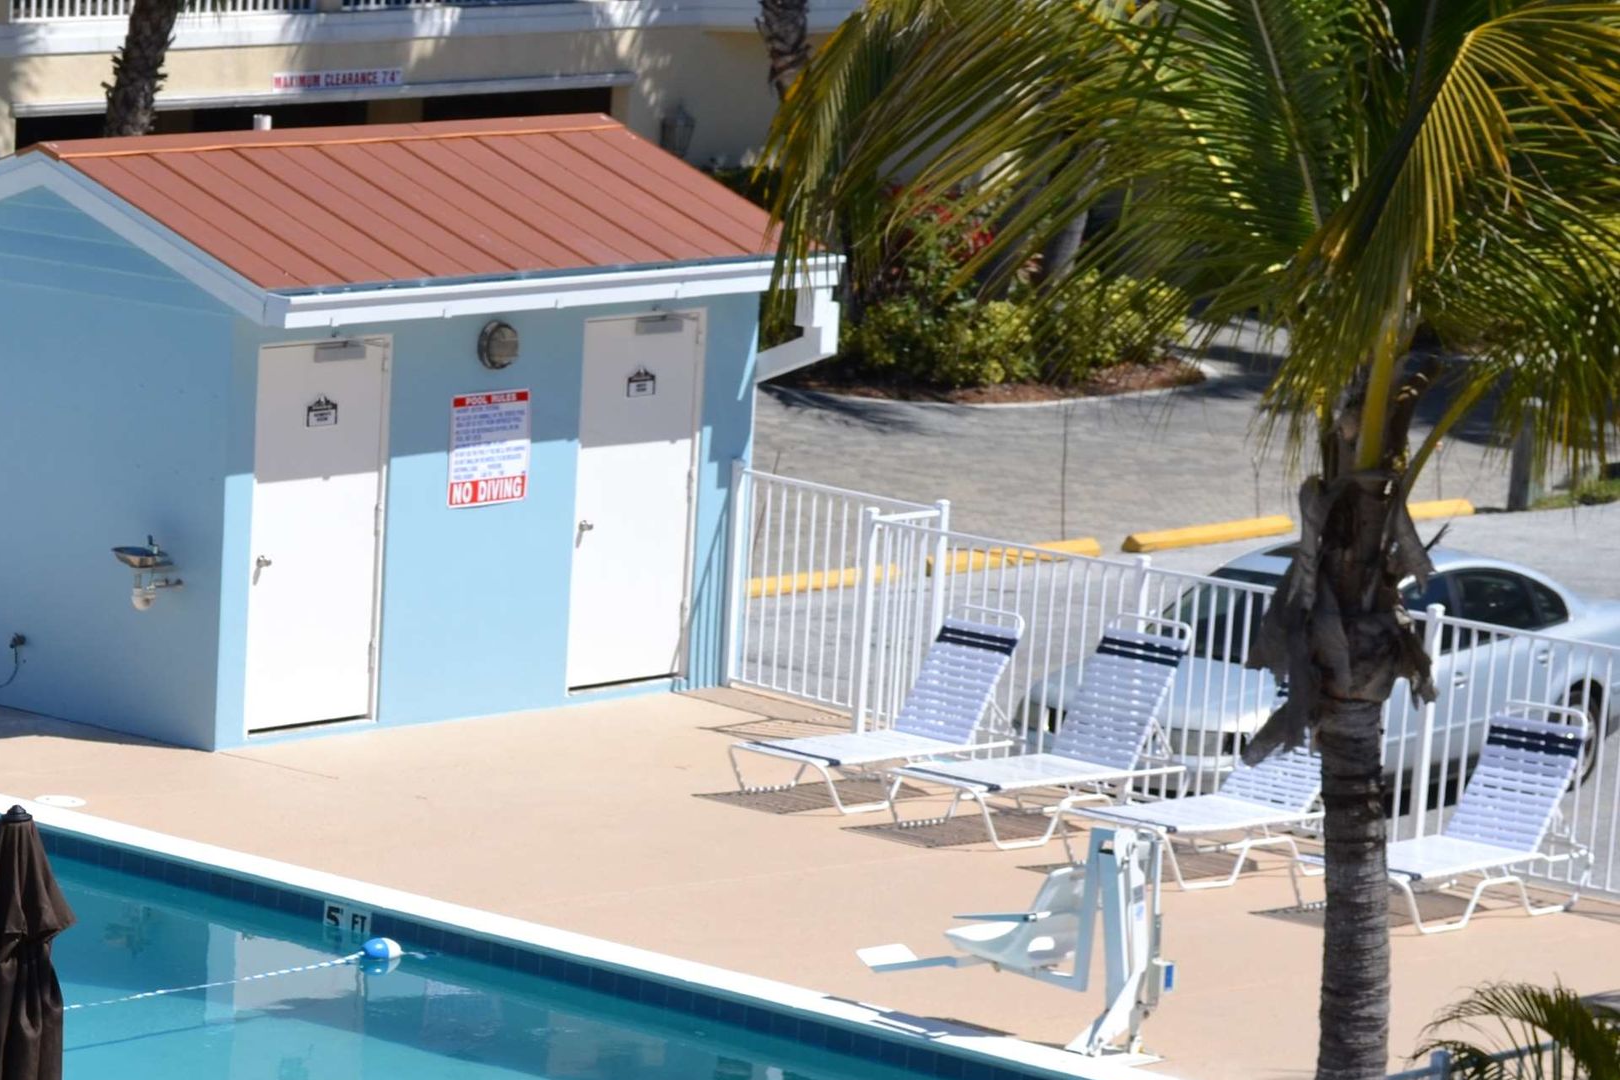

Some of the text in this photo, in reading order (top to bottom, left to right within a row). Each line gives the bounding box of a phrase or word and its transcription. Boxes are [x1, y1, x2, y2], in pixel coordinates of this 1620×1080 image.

[273, 74, 321, 89] MAXIMUM
[324, 71, 378, 88] CLEARANCE
[465, 393, 517, 406] POOL RULES
[451, 477, 522, 504] NO DIVING
[351, 913, 367, 933] FT
